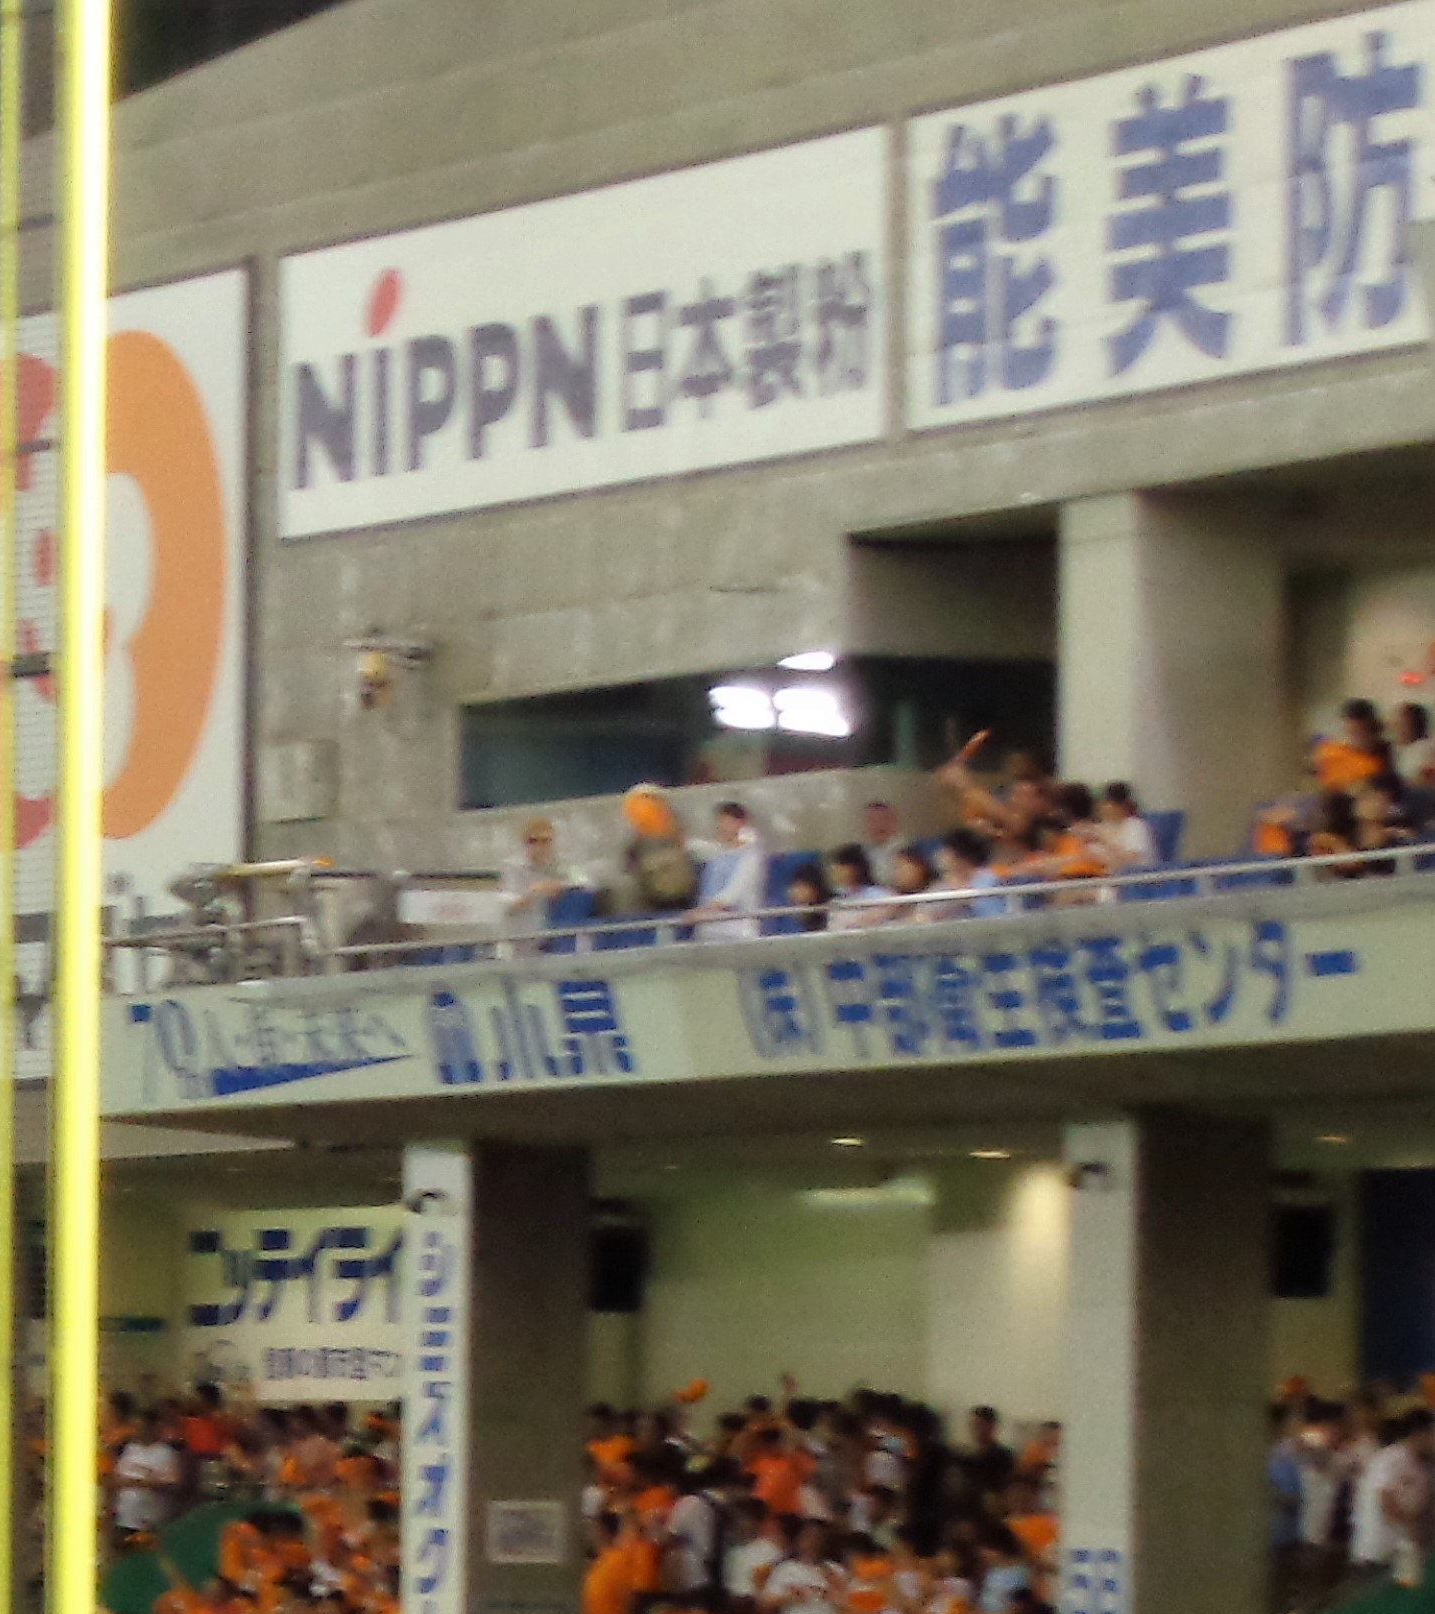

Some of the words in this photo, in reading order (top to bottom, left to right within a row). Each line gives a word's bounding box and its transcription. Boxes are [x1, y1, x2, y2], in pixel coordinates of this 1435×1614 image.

[292, 300, 600, 491] NIPPN
[620, 250, 872, 433] 日本製粉
[932, 30, 1424, 406] 能美防
